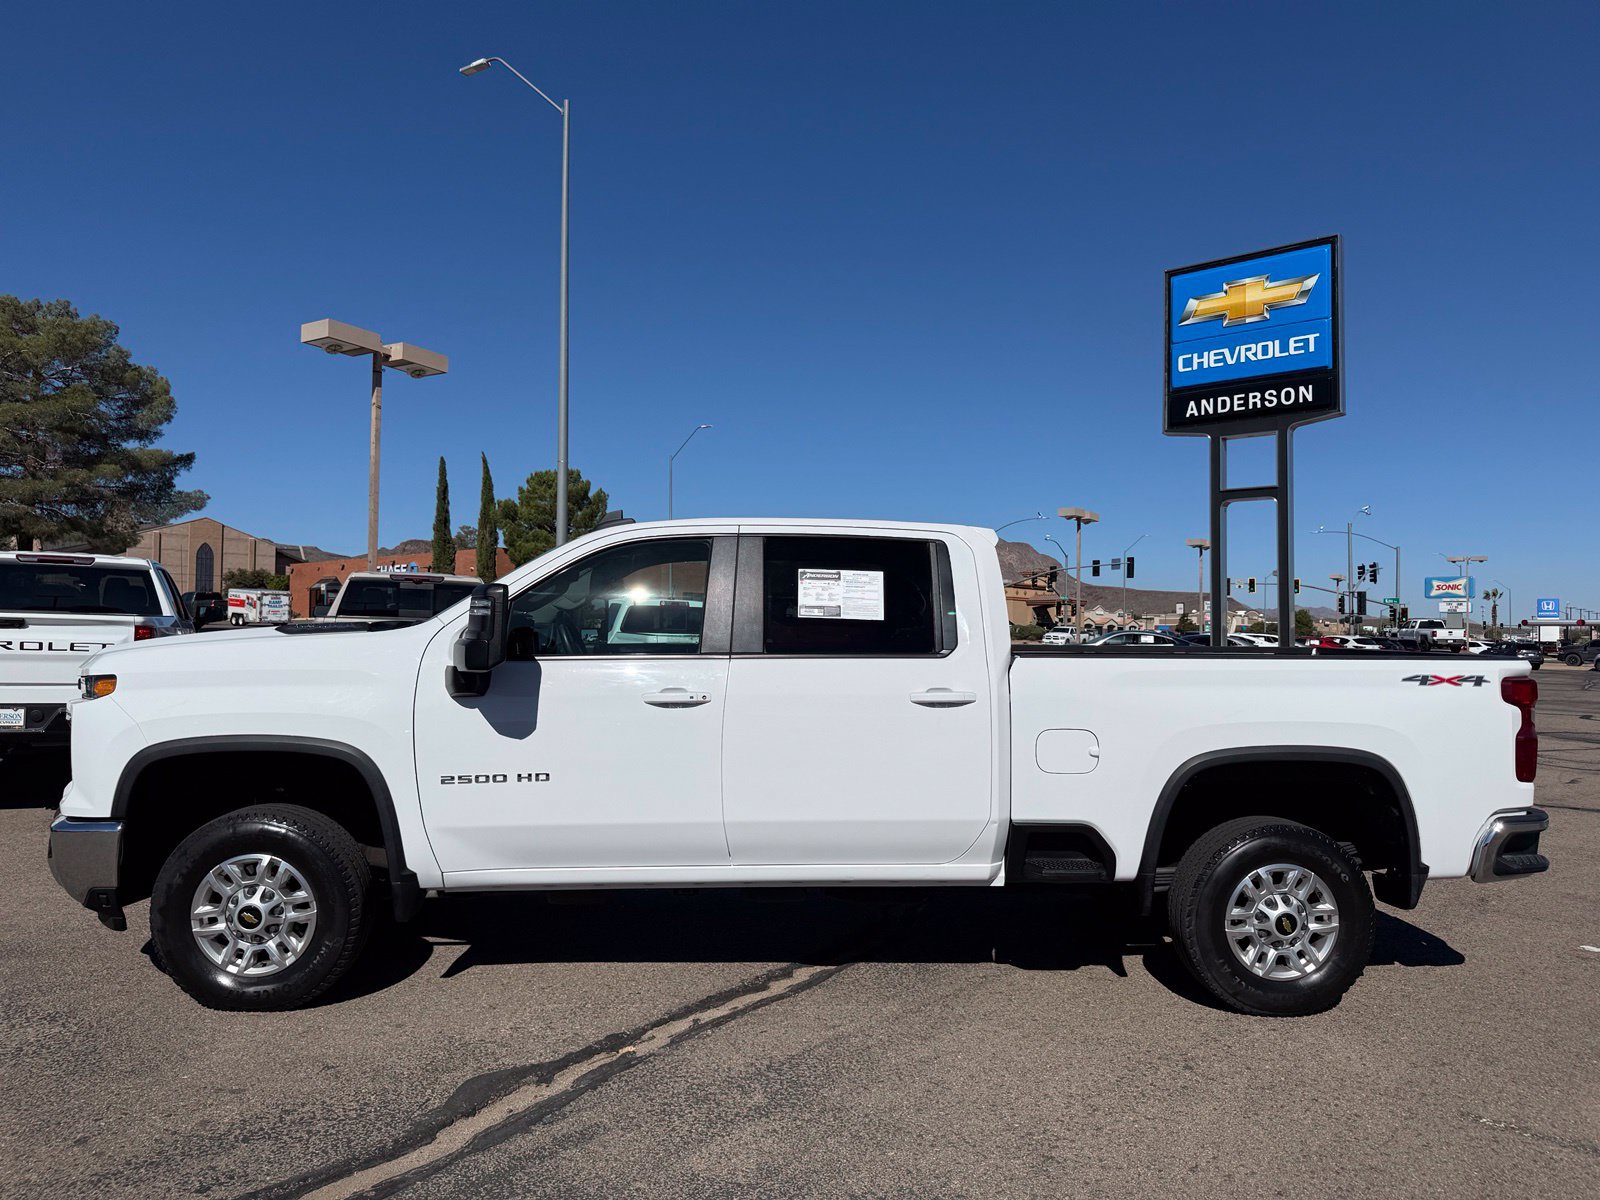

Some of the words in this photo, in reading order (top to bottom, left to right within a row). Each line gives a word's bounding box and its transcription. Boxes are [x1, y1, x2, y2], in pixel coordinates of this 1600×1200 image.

[1177, 333, 1320, 373] CHEVROLET
[1185, 384, 1313, 418] ANDERSON
[1435, 583, 1462, 591] SONIC
[440, 774, 508, 785] 2500
[516, 772, 550, 783] HD
